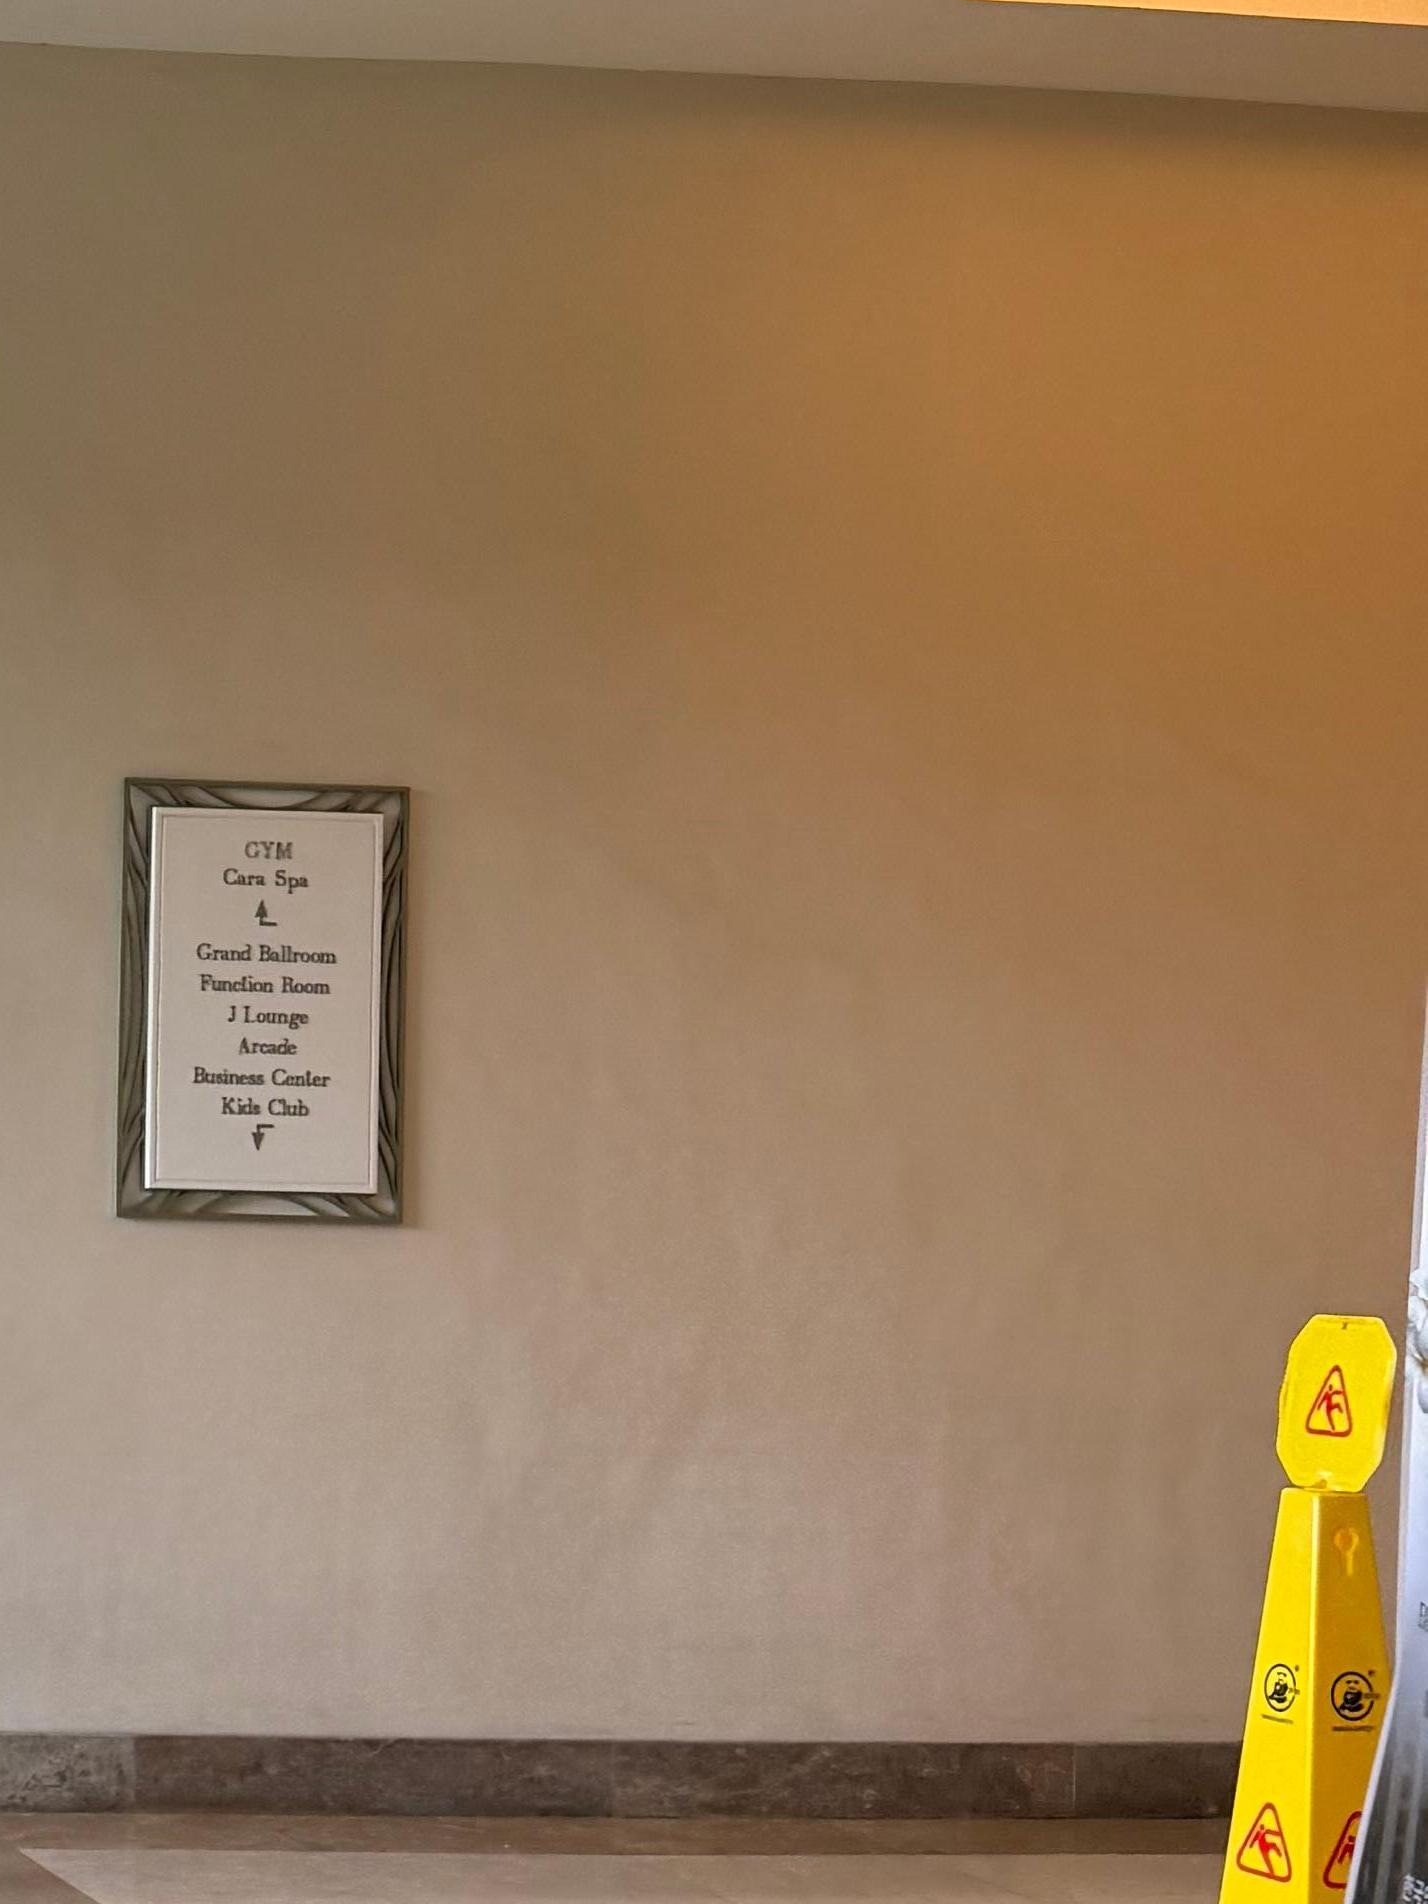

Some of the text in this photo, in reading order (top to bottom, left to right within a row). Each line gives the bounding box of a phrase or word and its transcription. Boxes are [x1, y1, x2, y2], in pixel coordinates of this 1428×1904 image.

[244, 840, 293, 860] GYM
[223, 867, 309, 895] Cara Spa
[196, 942, 337, 964] Grand Ballroom
[199, 973, 331, 994] Function Room
[227, 1005, 310, 1030] J Lounge
[238, 1036, 298, 1055] Arcade
[192, 1065, 331, 1087] Business Center
[221, 1096, 310, 1117] Kids Club
